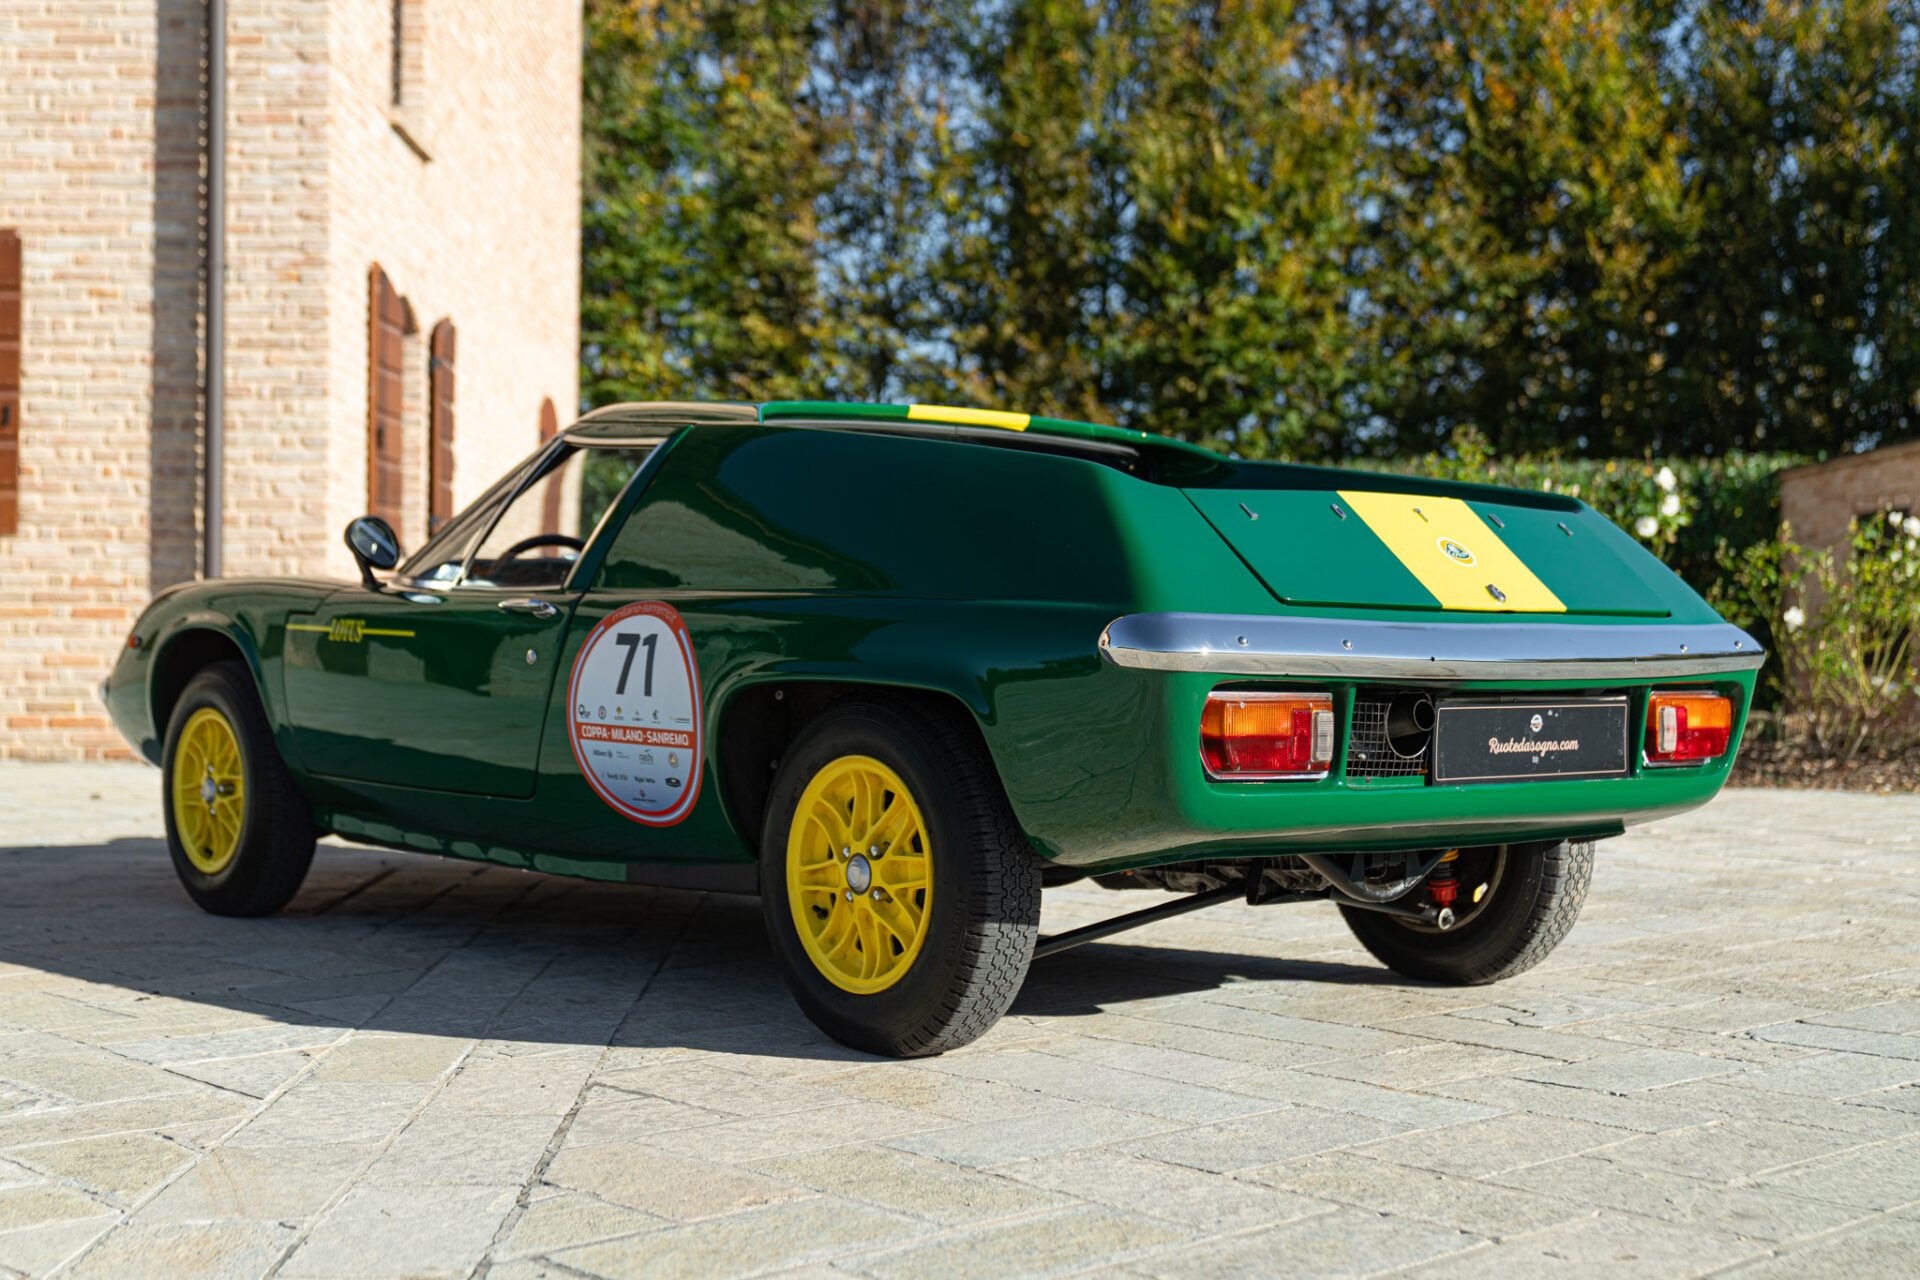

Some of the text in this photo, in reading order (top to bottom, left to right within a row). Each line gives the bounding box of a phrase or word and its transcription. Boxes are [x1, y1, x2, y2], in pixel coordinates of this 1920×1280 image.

[615, 632, 658, 697] 71
[581, 725, 689, 746] COPPA MILANO SANREMO
[1488, 737, 1579, 757] Ruotedasogno.com
